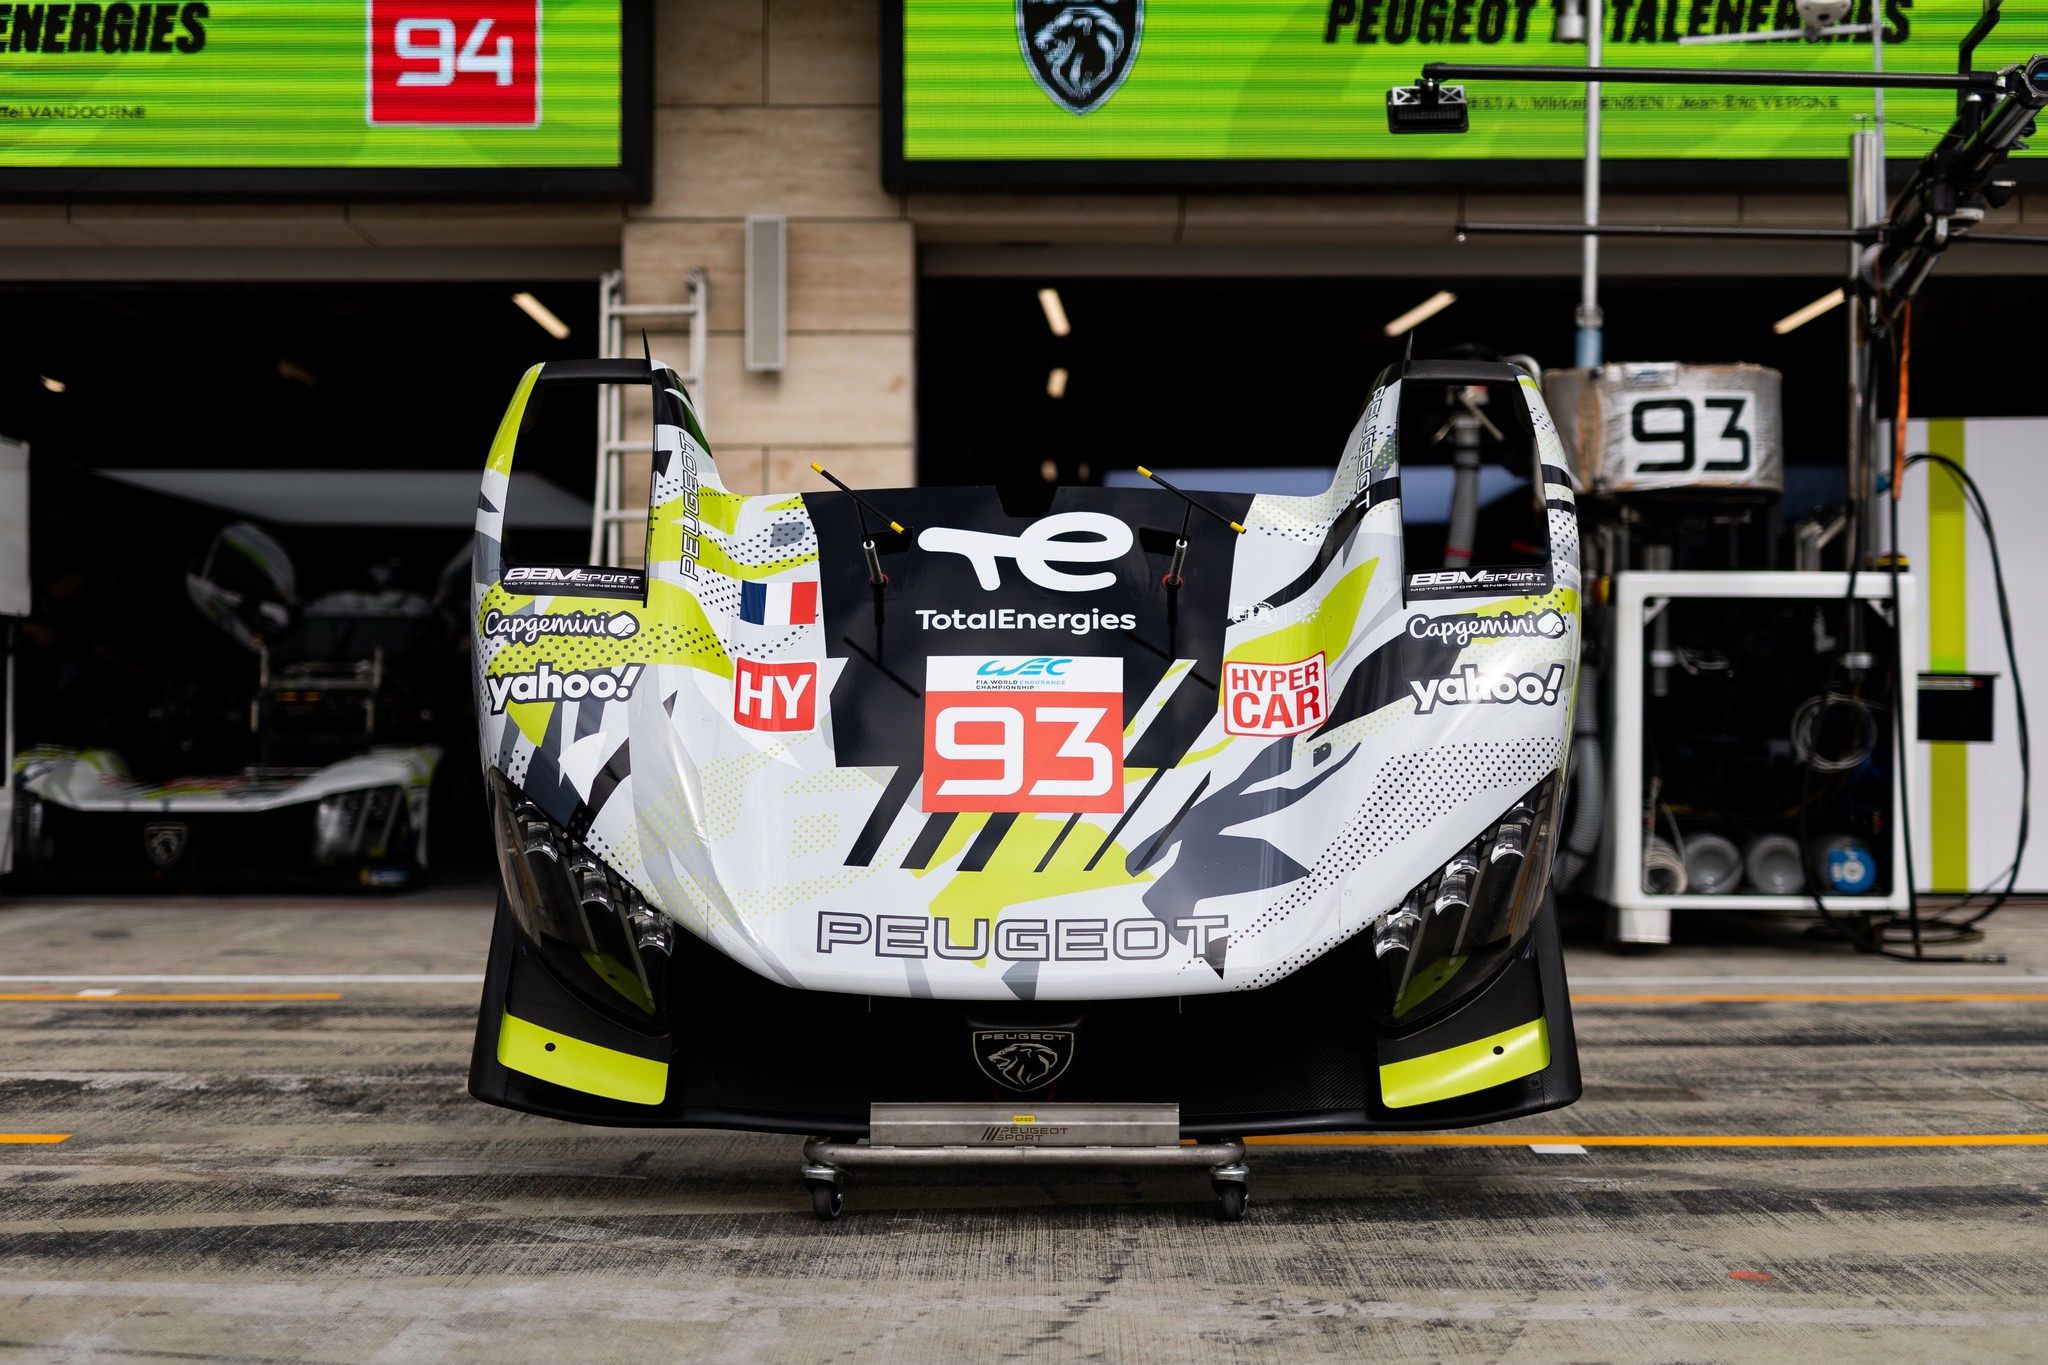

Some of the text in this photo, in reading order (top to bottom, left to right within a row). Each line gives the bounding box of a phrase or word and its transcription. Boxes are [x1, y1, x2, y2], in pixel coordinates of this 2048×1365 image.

[1325, 0, 1535, 43] PEUGEOT
[394, 18, 514, 87] 94
[27, 105, 147, 118] VANDOORNE
[1355, 385, 1386, 508] PEUGEOT
[1631, 398, 1751, 473] 93
[678, 431, 702, 583] PEUGEOT
[1410, 584, 1479, 592] MOTORSPORT
[484, 611, 607, 643] Capgemini
[916, 607, 1137, 635] TotalEnergies
[1409, 614, 1537, 646] Capgemini
[976, 657, 1073, 676] WEC
[1231, 660, 1320, 692] HYPER
[487, 664, 643, 713] yahoo!
[738, 668, 813, 720] HY
[1232, 687, 1323, 730] CAR
[1409, 666, 1564, 712] yahoo!
[935, 706, 1113, 796] 93
[816, 910, 1229, 962] PEUGEOT
[1000, 1127, 1069, 1135] PEUGEOT
